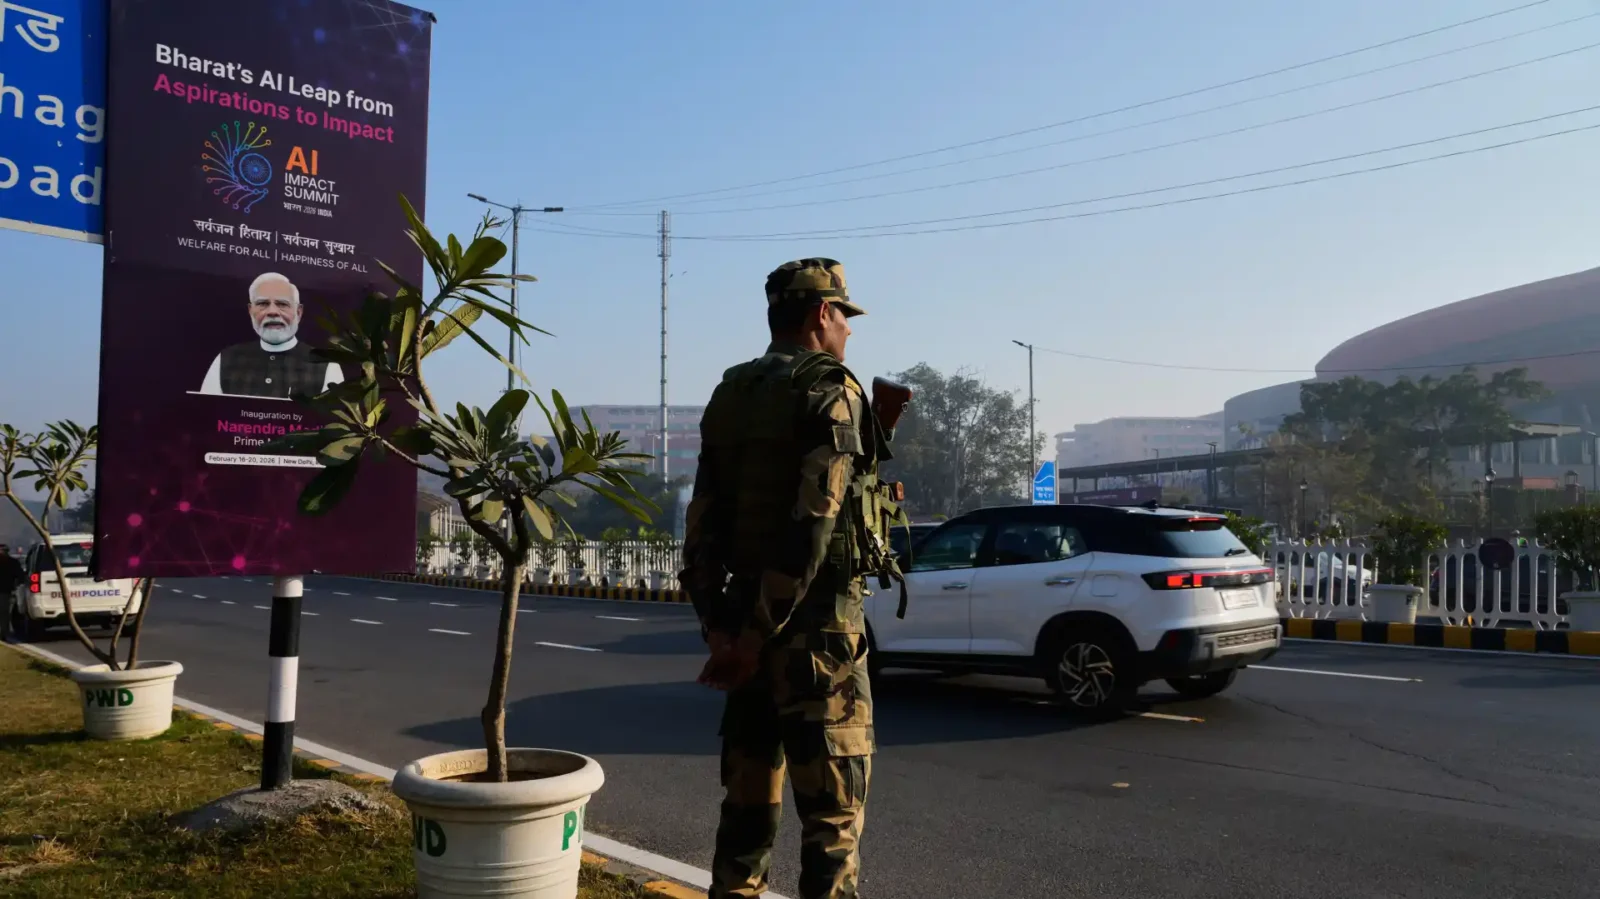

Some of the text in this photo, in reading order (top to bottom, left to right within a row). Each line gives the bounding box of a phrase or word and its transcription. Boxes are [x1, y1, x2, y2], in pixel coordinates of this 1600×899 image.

[259, 70, 282, 91] AI
[288, 76, 341, 107] Leap
[346, 90, 394, 117] from
[153, 73, 394, 143] Aspirations to Impact
[285, 145, 318, 176] AI
[284, 172, 336, 192] IMPACT
[284, 185, 340, 206] SUMMIT
[317, 208, 333, 218] INDIA
[193, 218, 234, 237] सर्वजन
[238, 223, 271, 242] हिताय
[281, 232, 320, 250] सर्वजन
[177, 236, 368, 274] WELFARE FOR ALL HAPPINESS OF ALL
[240, 409, 303, 423] Inauguration by
[217, 419, 286, 436] Narendra
[233, 435, 265, 447] Prime
[208, 454, 237, 464] February
[260, 457, 276, 465] 2026
[51, 588, 121, 599] DEHI POLICE
[86, 687, 134, 707] PWD
